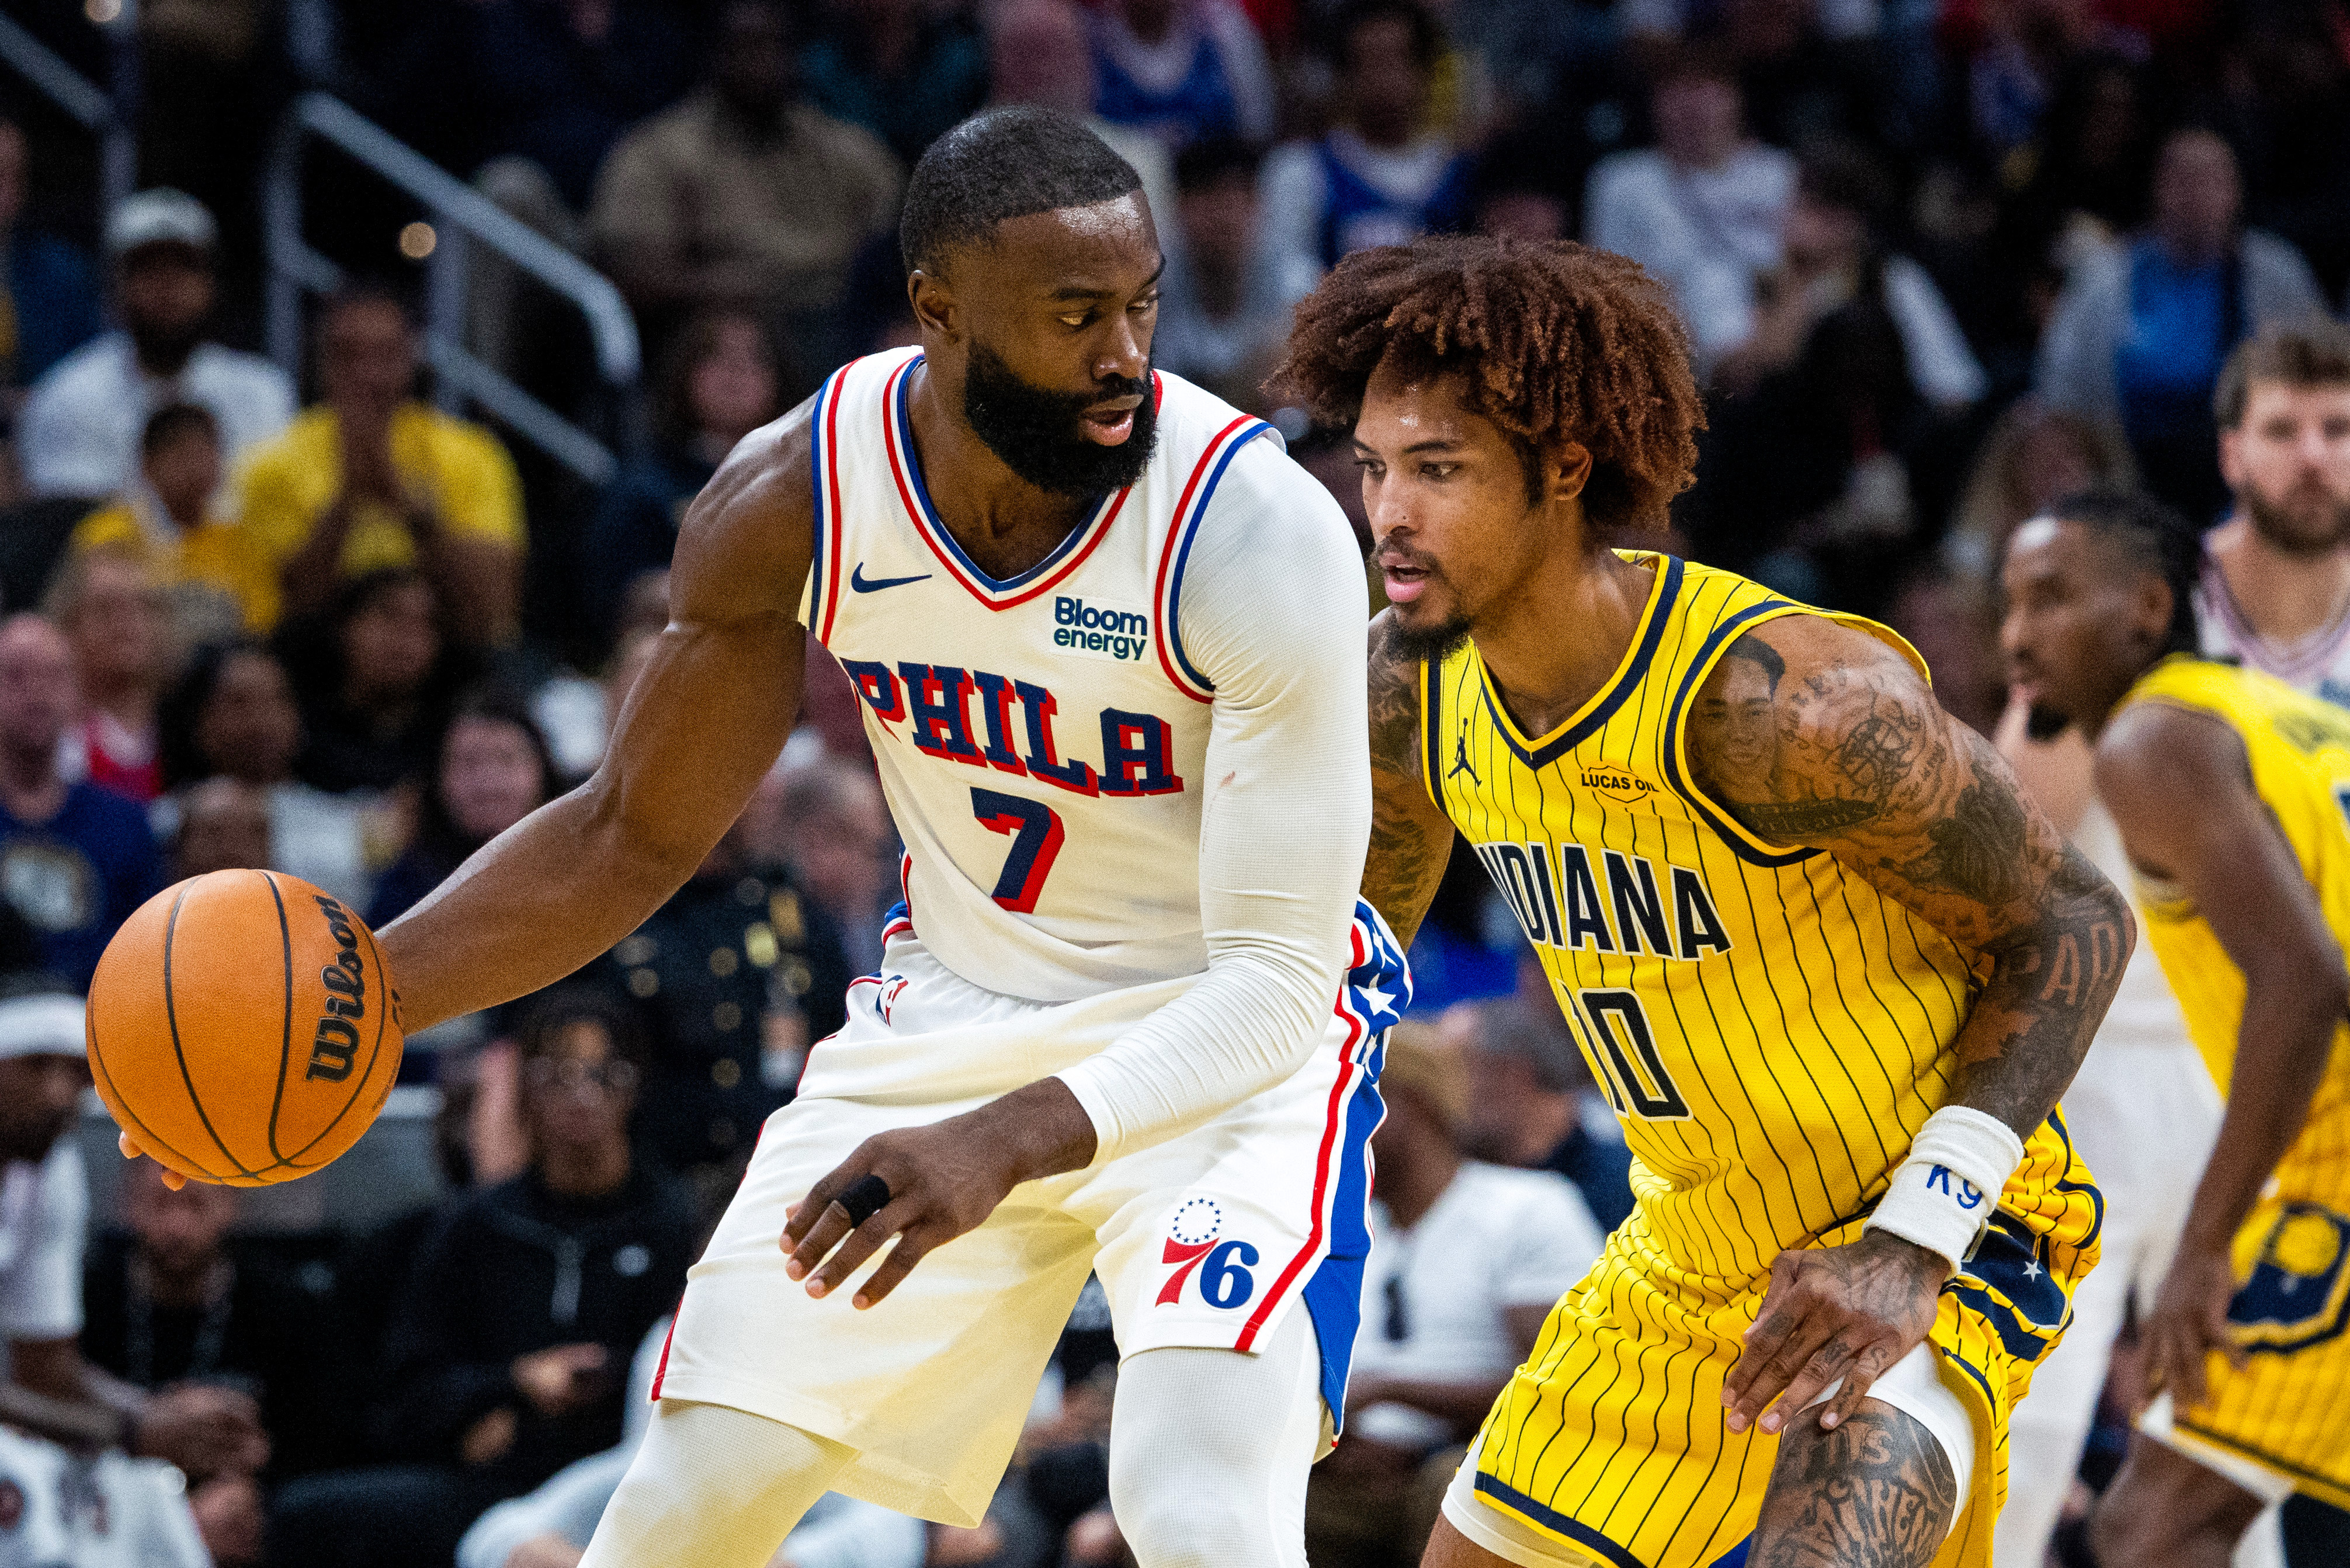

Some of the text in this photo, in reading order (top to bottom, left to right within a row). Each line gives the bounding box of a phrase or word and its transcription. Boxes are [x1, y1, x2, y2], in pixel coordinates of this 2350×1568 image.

[1054, 628, 1147, 661] energy
[1055, 596, 1147, 636] Bloom
[839, 657, 1185, 798] PHILA
[1581, 773, 1660, 793] LUCAS OIL
[970, 786, 1065, 914] 7
[1472, 841, 1735, 962] NDIANA
[304, 895, 365, 1082] Wilson
[1155, 1236, 1259, 1309] 76
